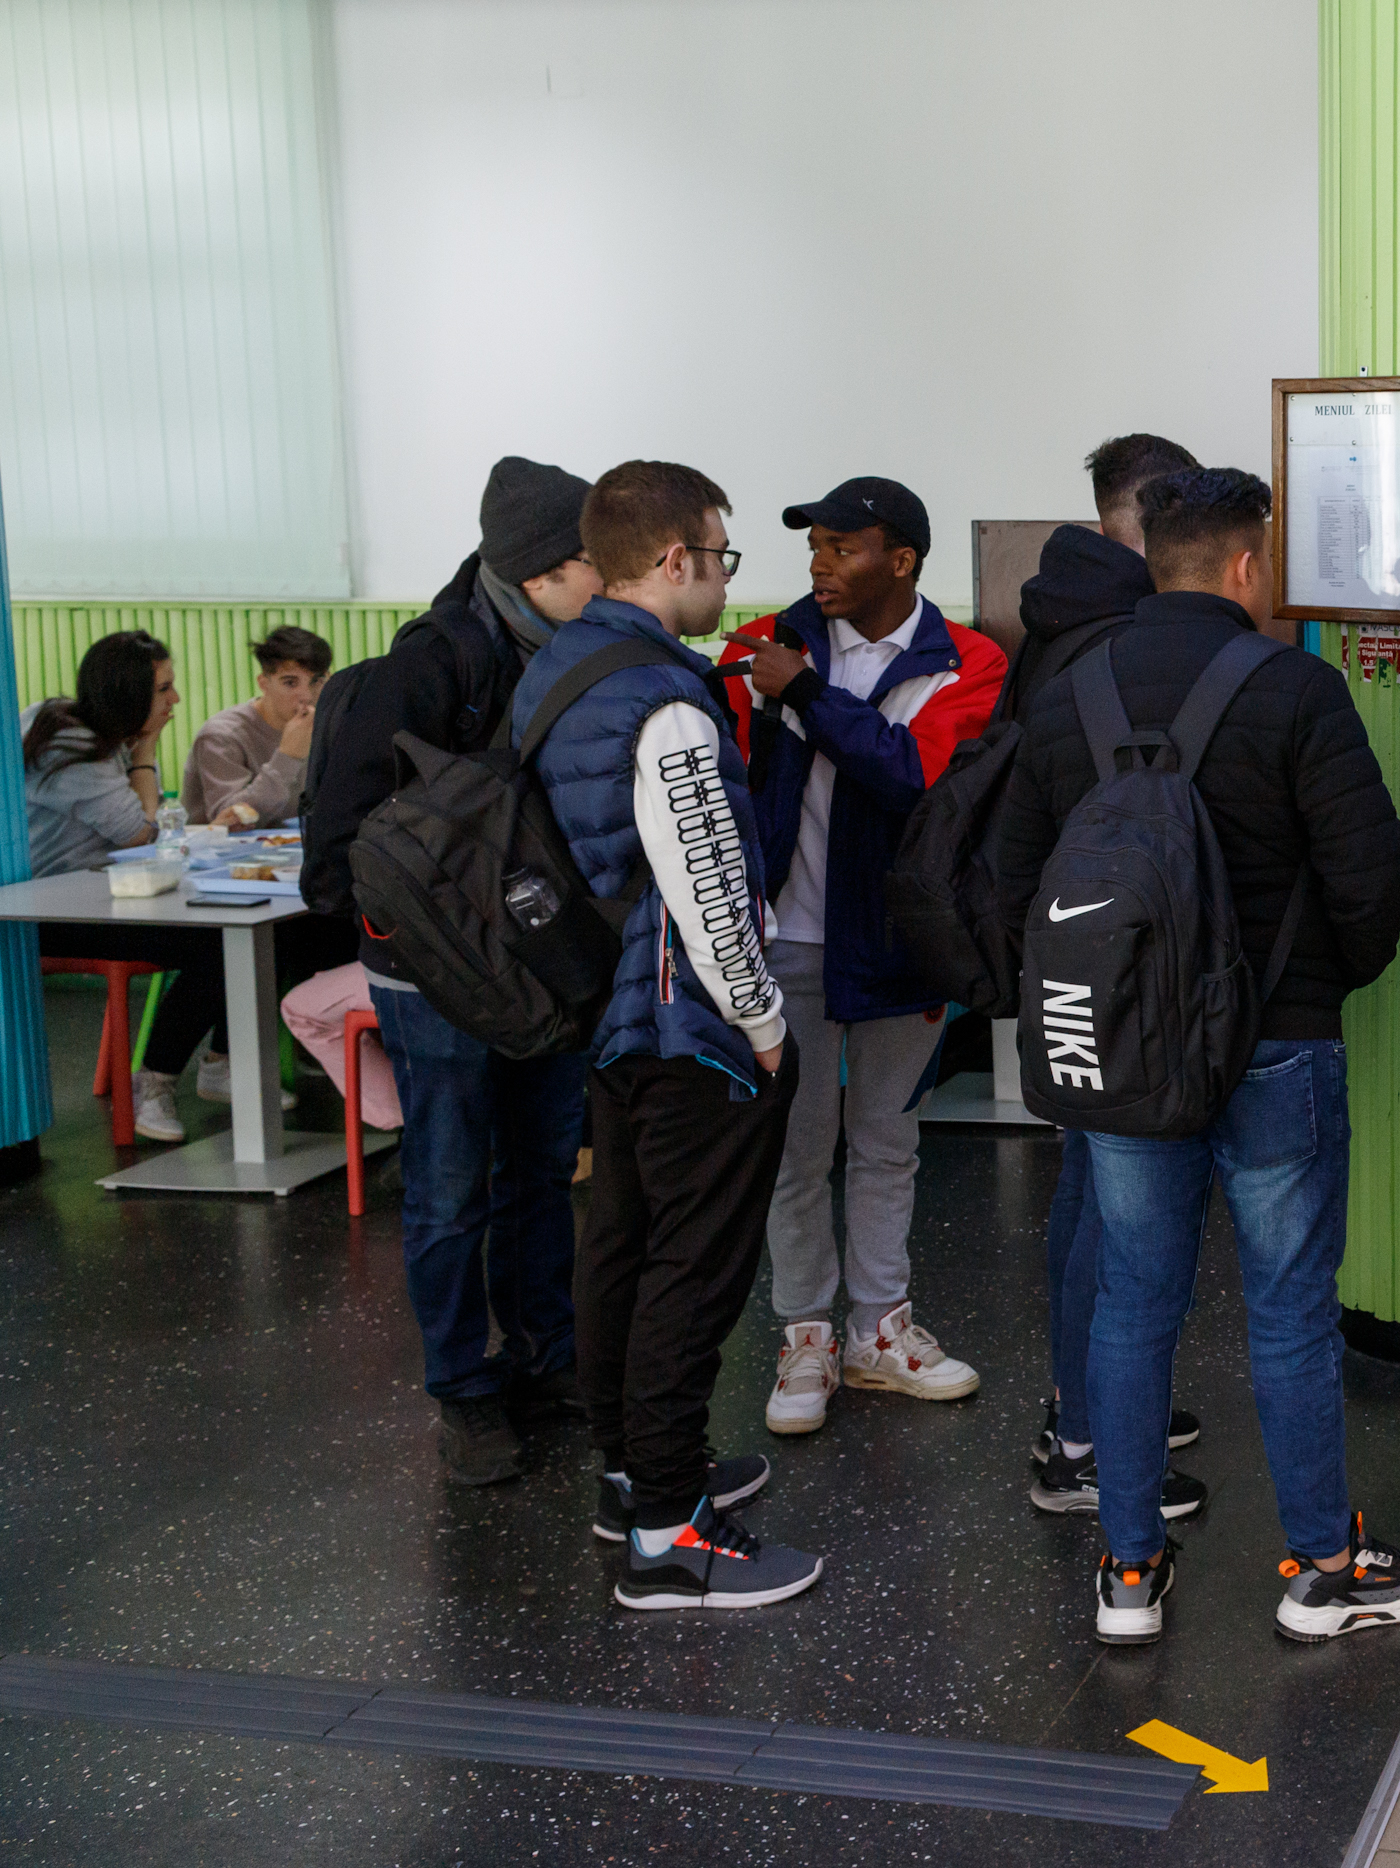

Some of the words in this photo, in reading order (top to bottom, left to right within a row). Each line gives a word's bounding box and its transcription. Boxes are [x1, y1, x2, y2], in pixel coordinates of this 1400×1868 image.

[1314, 405, 1355, 416] MENIUL
[1364, 404, 1392, 415] ZILEI
[1361, 649, 1393, 658] Siguanță
[1042, 979, 1104, 1091] NIKE
